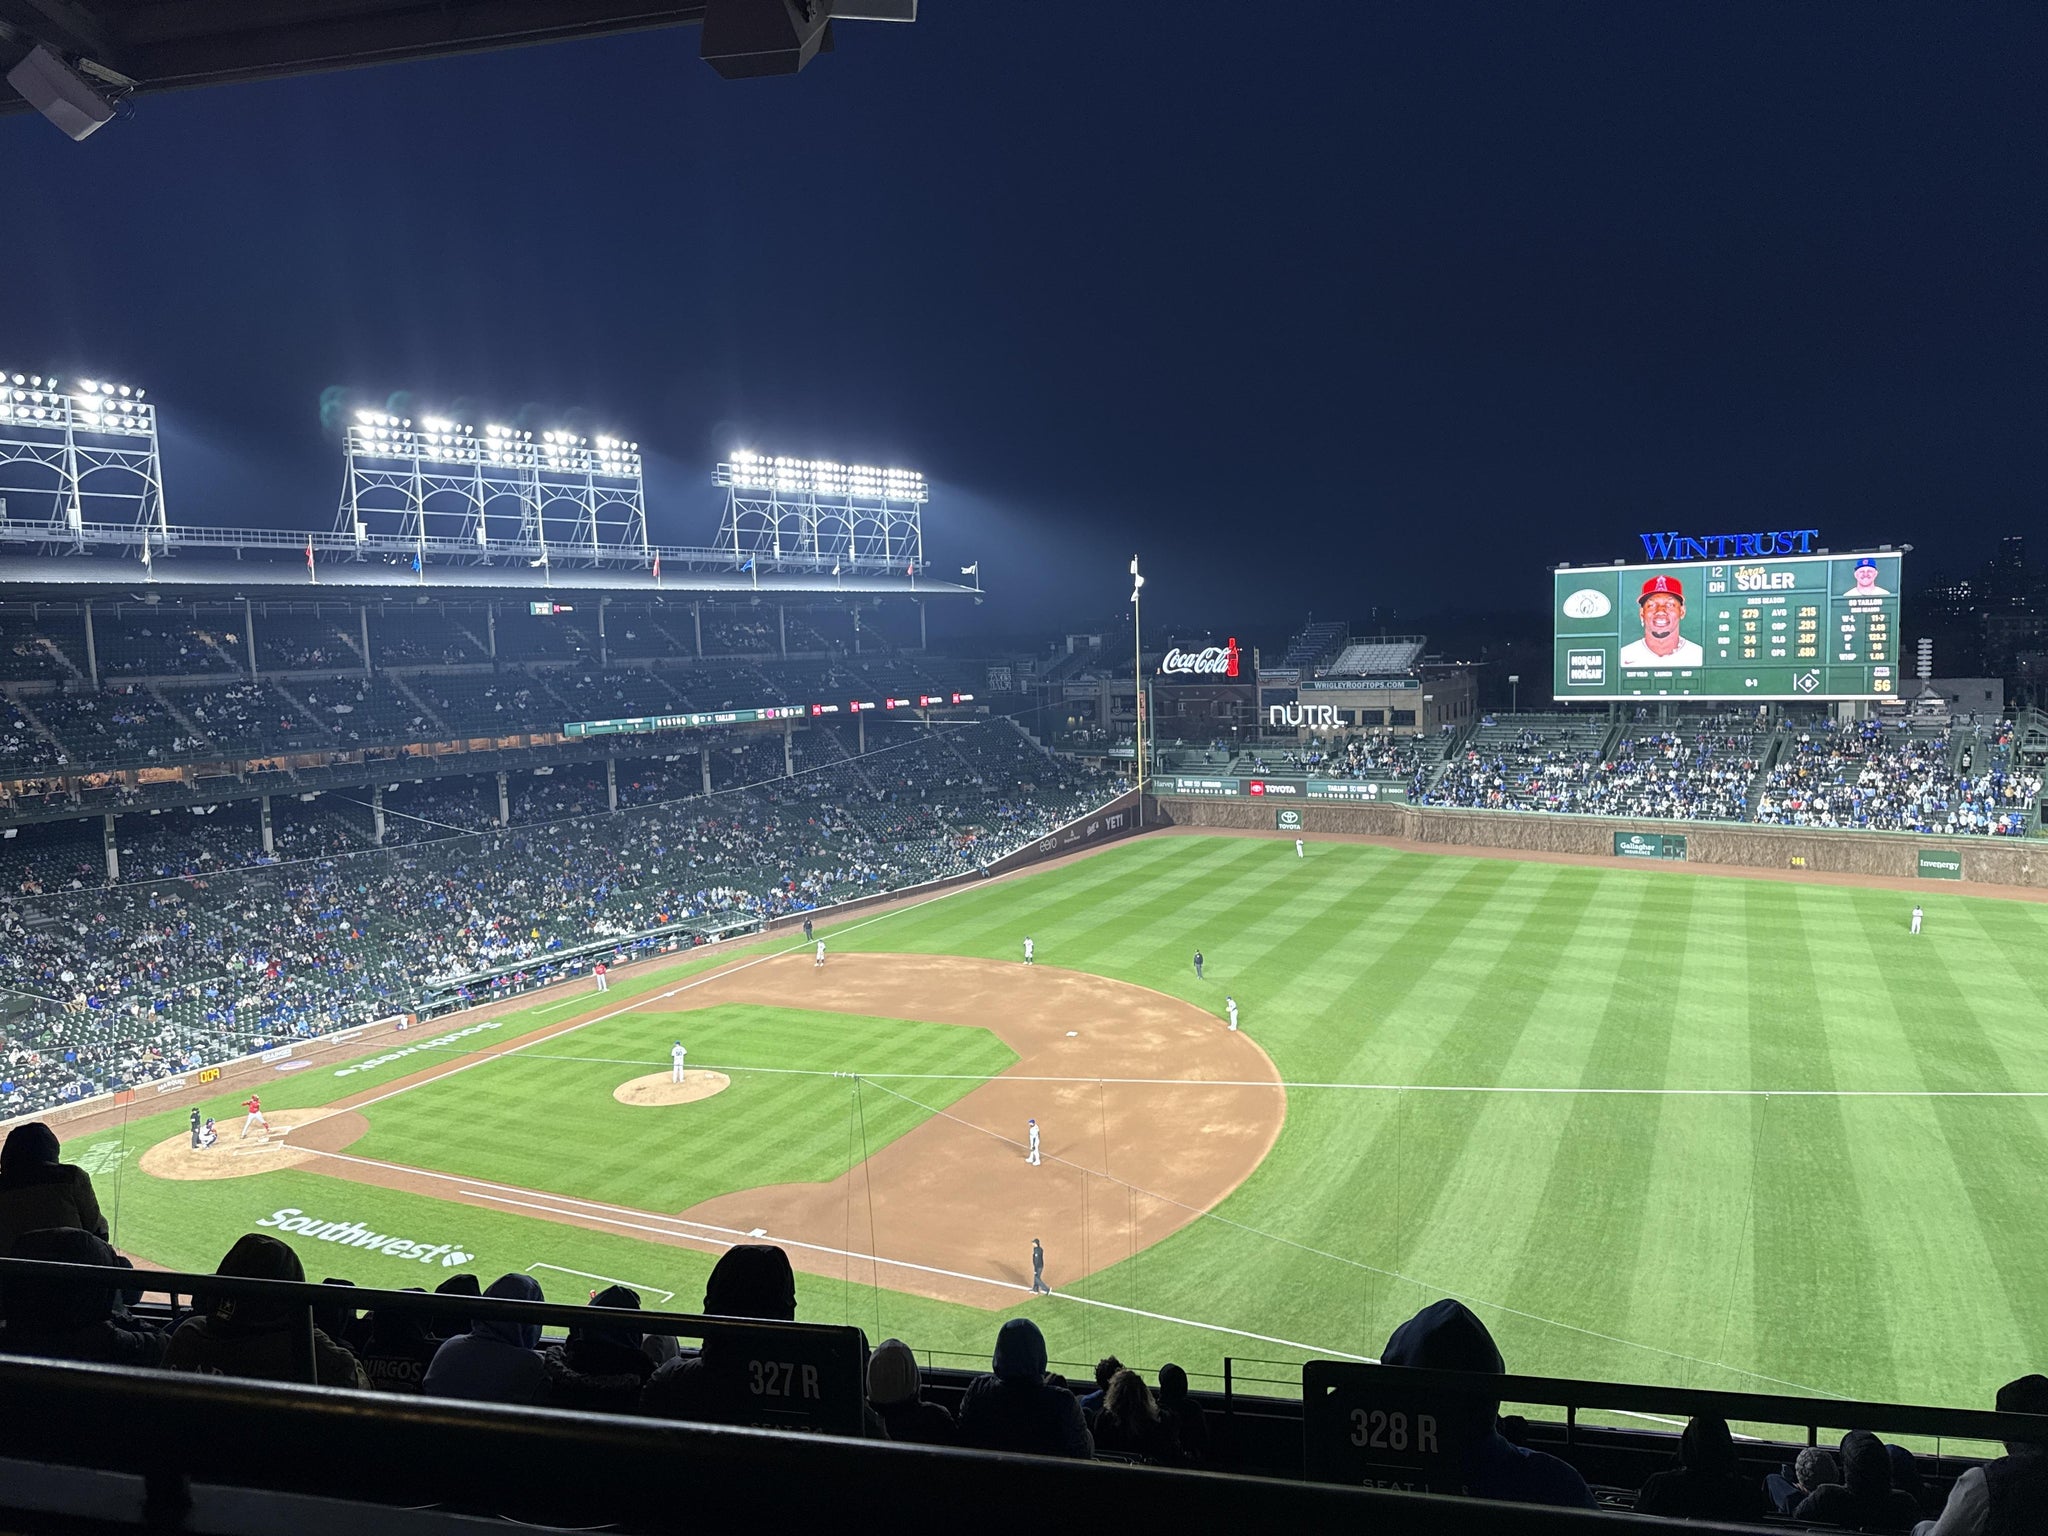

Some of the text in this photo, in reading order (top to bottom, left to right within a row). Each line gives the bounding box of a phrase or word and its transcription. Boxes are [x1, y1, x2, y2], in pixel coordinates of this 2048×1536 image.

[1640, 529, 1818, 560] WINTRUST
[1712, 567, 1723, 577] 12
[1737, 572, 1795, 590] SOLER
[1709, 582, 1725, 593] DH
[1742, 609, 1759, 618] 279
[1798, 607, 1816, 616] .215
[1745, 622, 1756, 631] 12
[1772, 622, 1786, 630] OBP
[1798, 620, 1816, 630] .293
[1744, 635, 1756, 644] 34
[1798, 634, 1816, 643] .387
[1744, 648, 1756, 658] 31
[1771, 649, 1786, 657] OPS
[1798, 647, 1816, 657] .680
[1162, 646, 1232, 674] Coca-Cola
[1571, 656, 1602, 666] MORGAN
[1571, 669, 1603, 679] MORGAN
[1314, 681, 1405, 690] WRIGLEYROOFTOPS.COM
[1874, 680, 1891, 692] 56
[1270, 701, 1347, 726] NÜTRL
[1154, 780, 1174, 788] Harvey
[1265, 785, 1296, 794] TOYOTA
[1105, 814, 1123, 831] YETI
[1039, 838, 1057, 852] eero
[1620, 842, 1655, 851] Gallagher
[1920, 859, 1960, 871] Invenergy
[256, 1208, 452, 1264] Southwest
[748, 1360, 821, 1399] 327 R
[1350, 1408, 1439, 1454] 328 R
